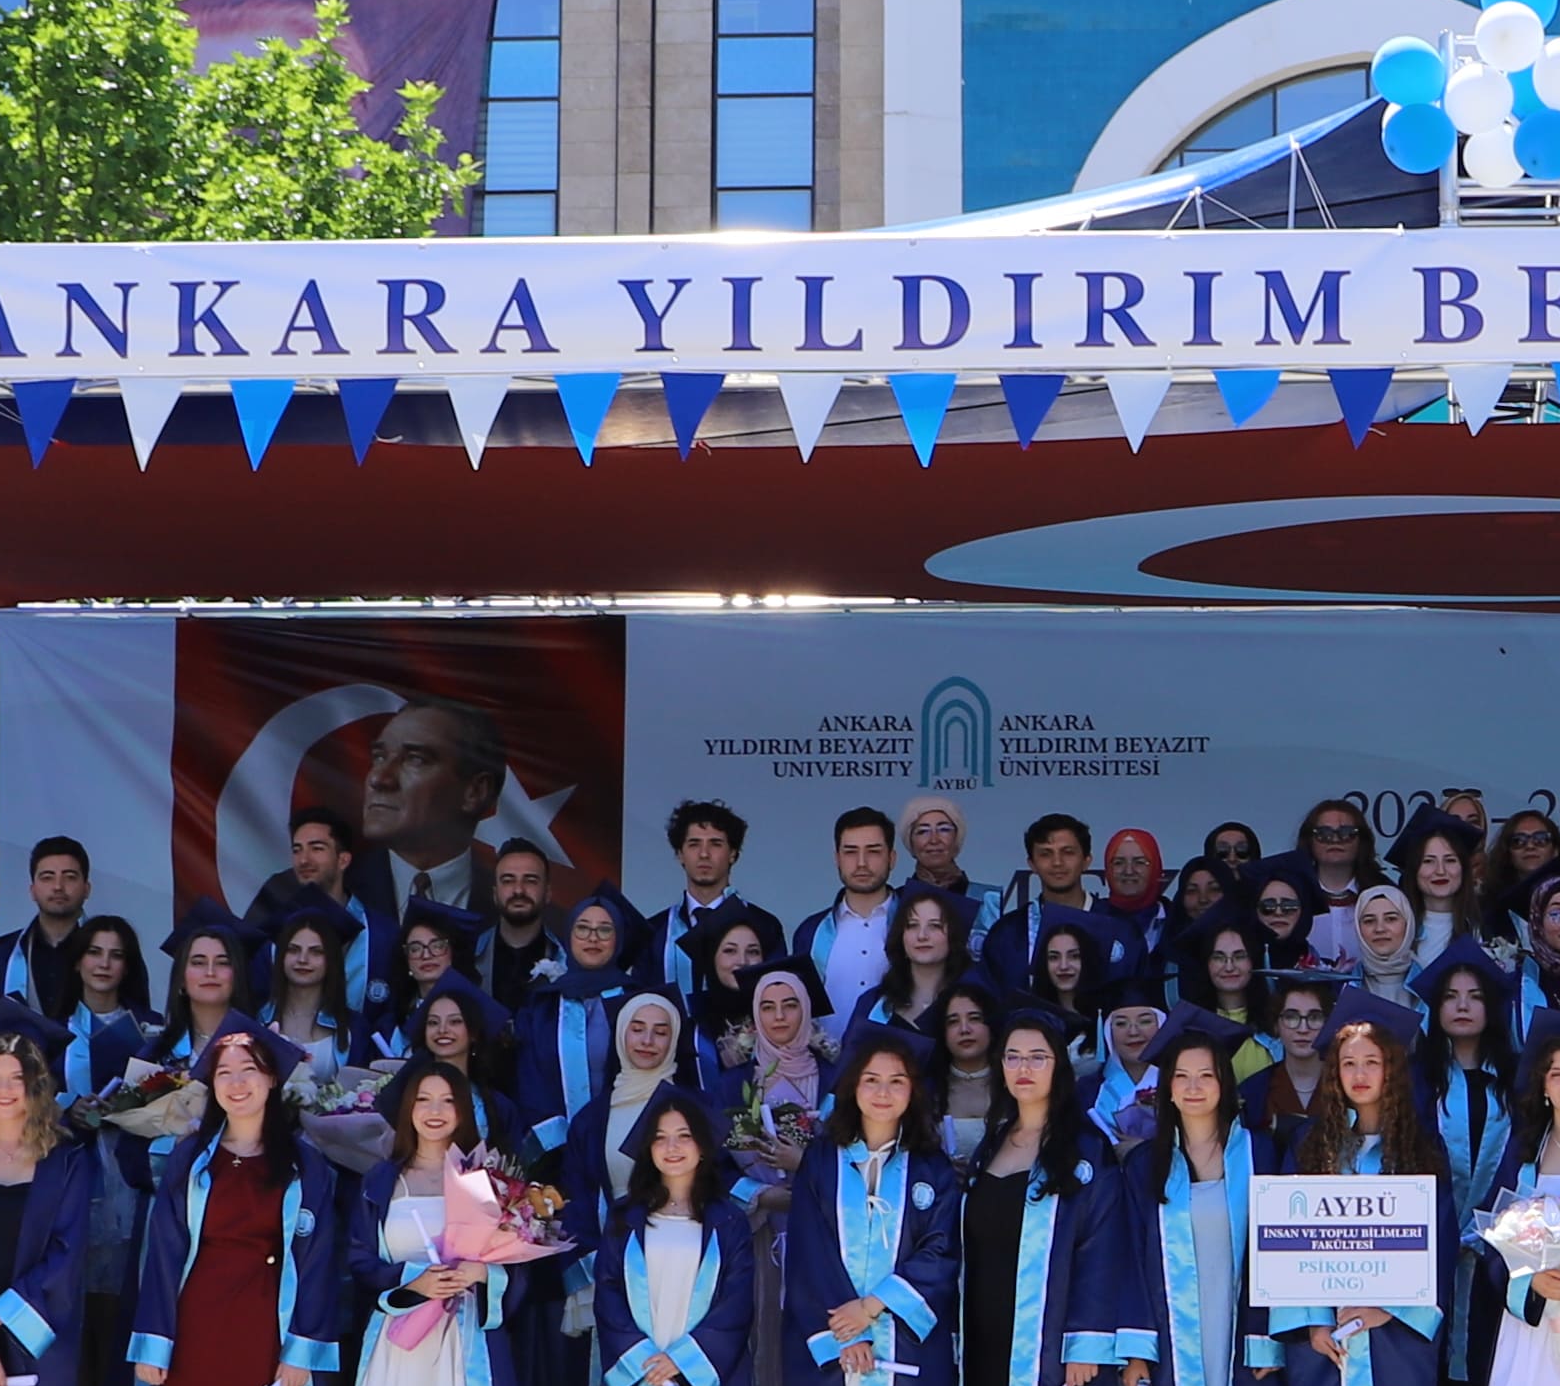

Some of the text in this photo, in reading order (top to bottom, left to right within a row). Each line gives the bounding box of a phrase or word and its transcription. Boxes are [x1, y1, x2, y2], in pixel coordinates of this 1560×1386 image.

[617, 270, 1351, 353] YILDIRIM
[817, 715, 914, 734] ANKARA
[998, 713, 1095, 732] ANKARA
[703, 737, 915, 757] YILDIRIM BEYAZIT
[1000, 735, 1210, 755] YILDIRIM BEYAZIT
[772, 760, 914, 778] UNIVERSITY
[999, 755, 1161, 778] ÜNİVERSİTESİ
[1314, 1191, 1398, 1218] AYBÜ
[1263, 1226, 1423, 1239] İNSAN VE TOPLU BİLİMLERİ
[1311, 1238, 1375, 1251] FAKÜLTESİ
